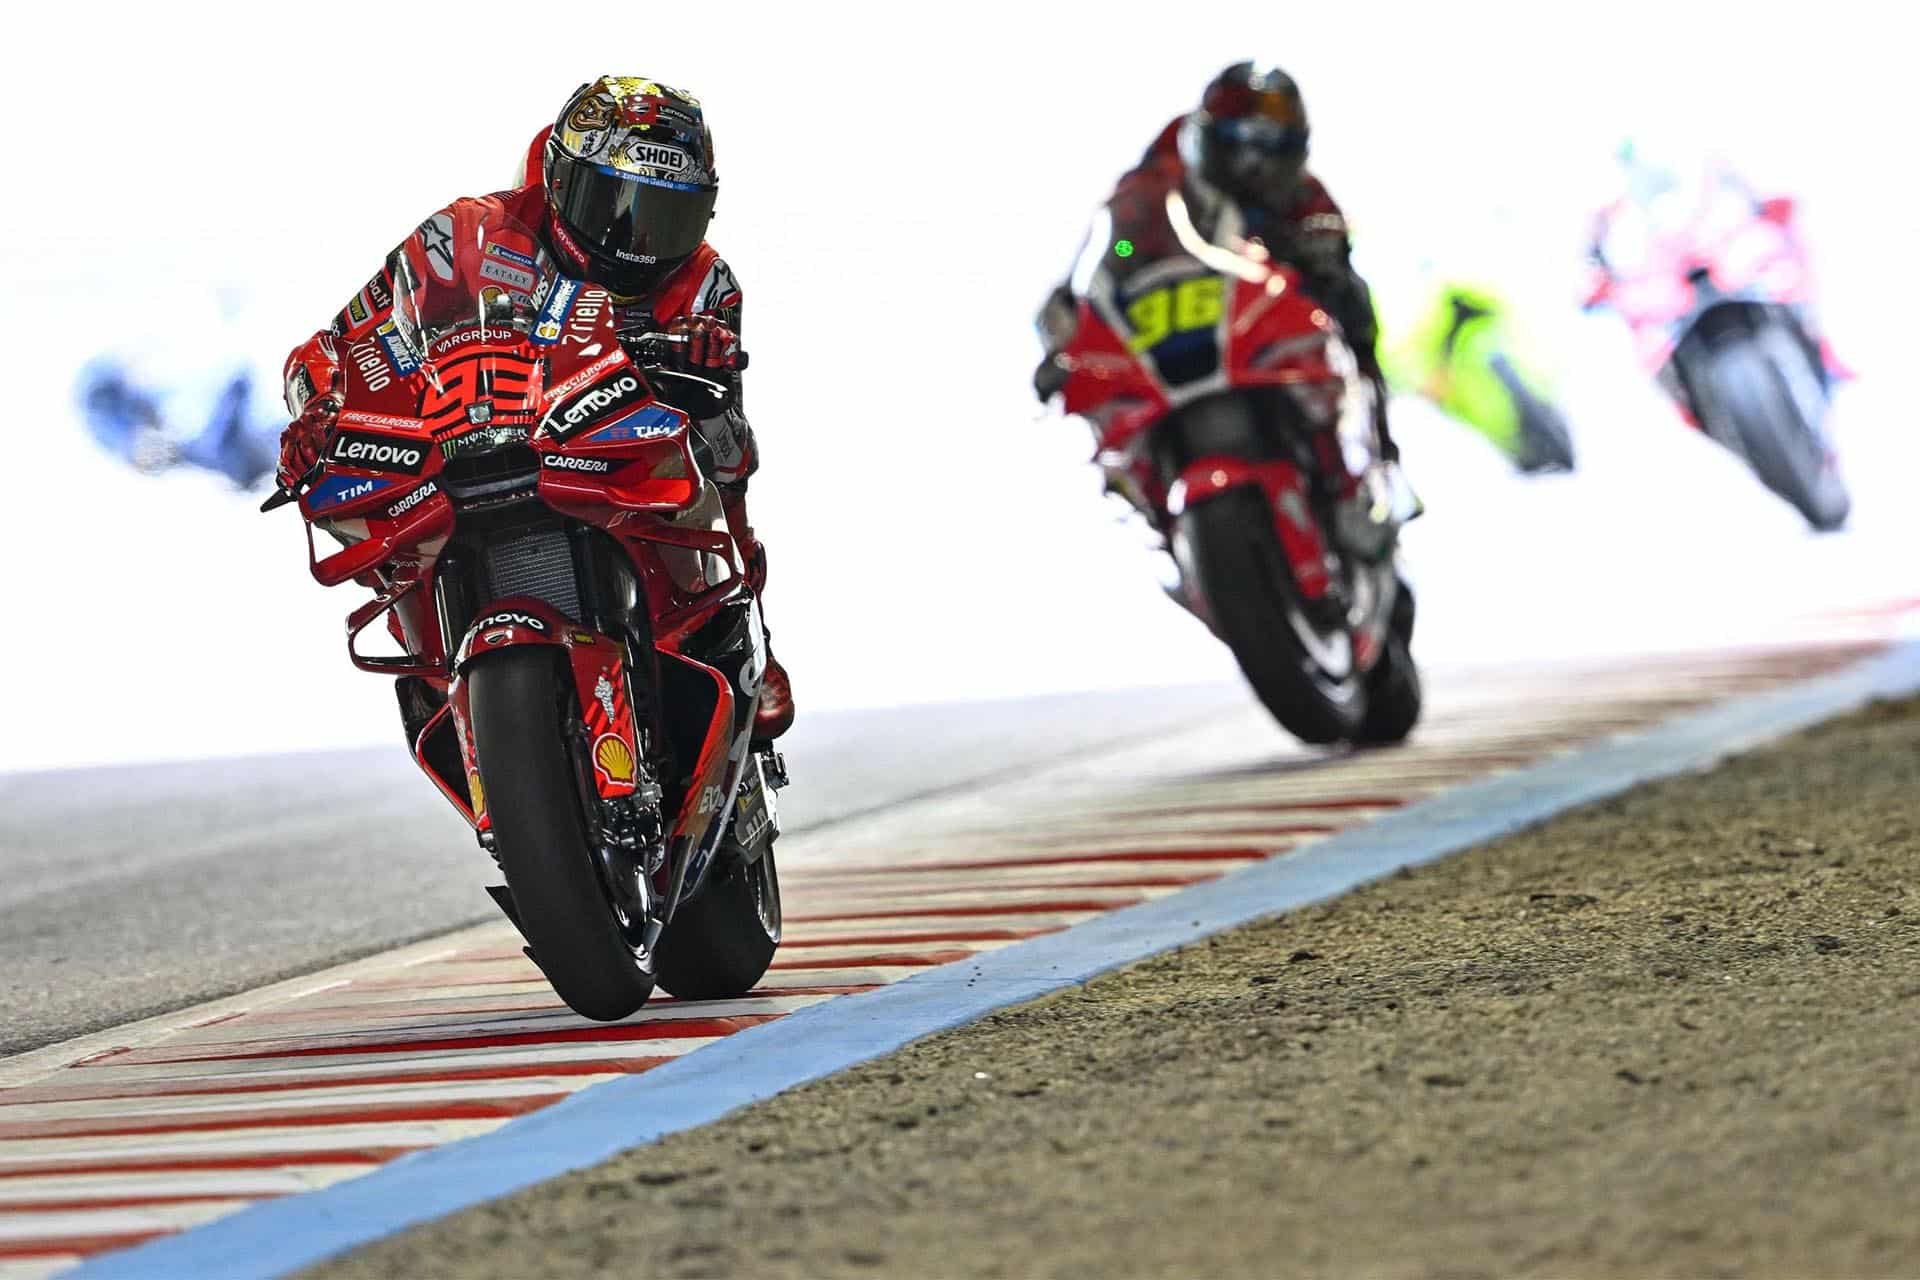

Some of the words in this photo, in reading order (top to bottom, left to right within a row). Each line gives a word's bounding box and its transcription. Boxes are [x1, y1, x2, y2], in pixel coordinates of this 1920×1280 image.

[636, 146, 683, 168] SHOEI
[553, 219, 585, 263] Lenovo
[616, 249, 656, 264] Insta360
[485, 265, 530, 284] EATALY
[548, 376, 638, 433] Lenovo
[335, 437, 421, 466] Lenovo
[544, 455, 608, 471] CARRERA
[337, 480, 373, 501] TIM
[388, 481, 438, 517] CARRERA
[477, 613, 544, 631] novo
